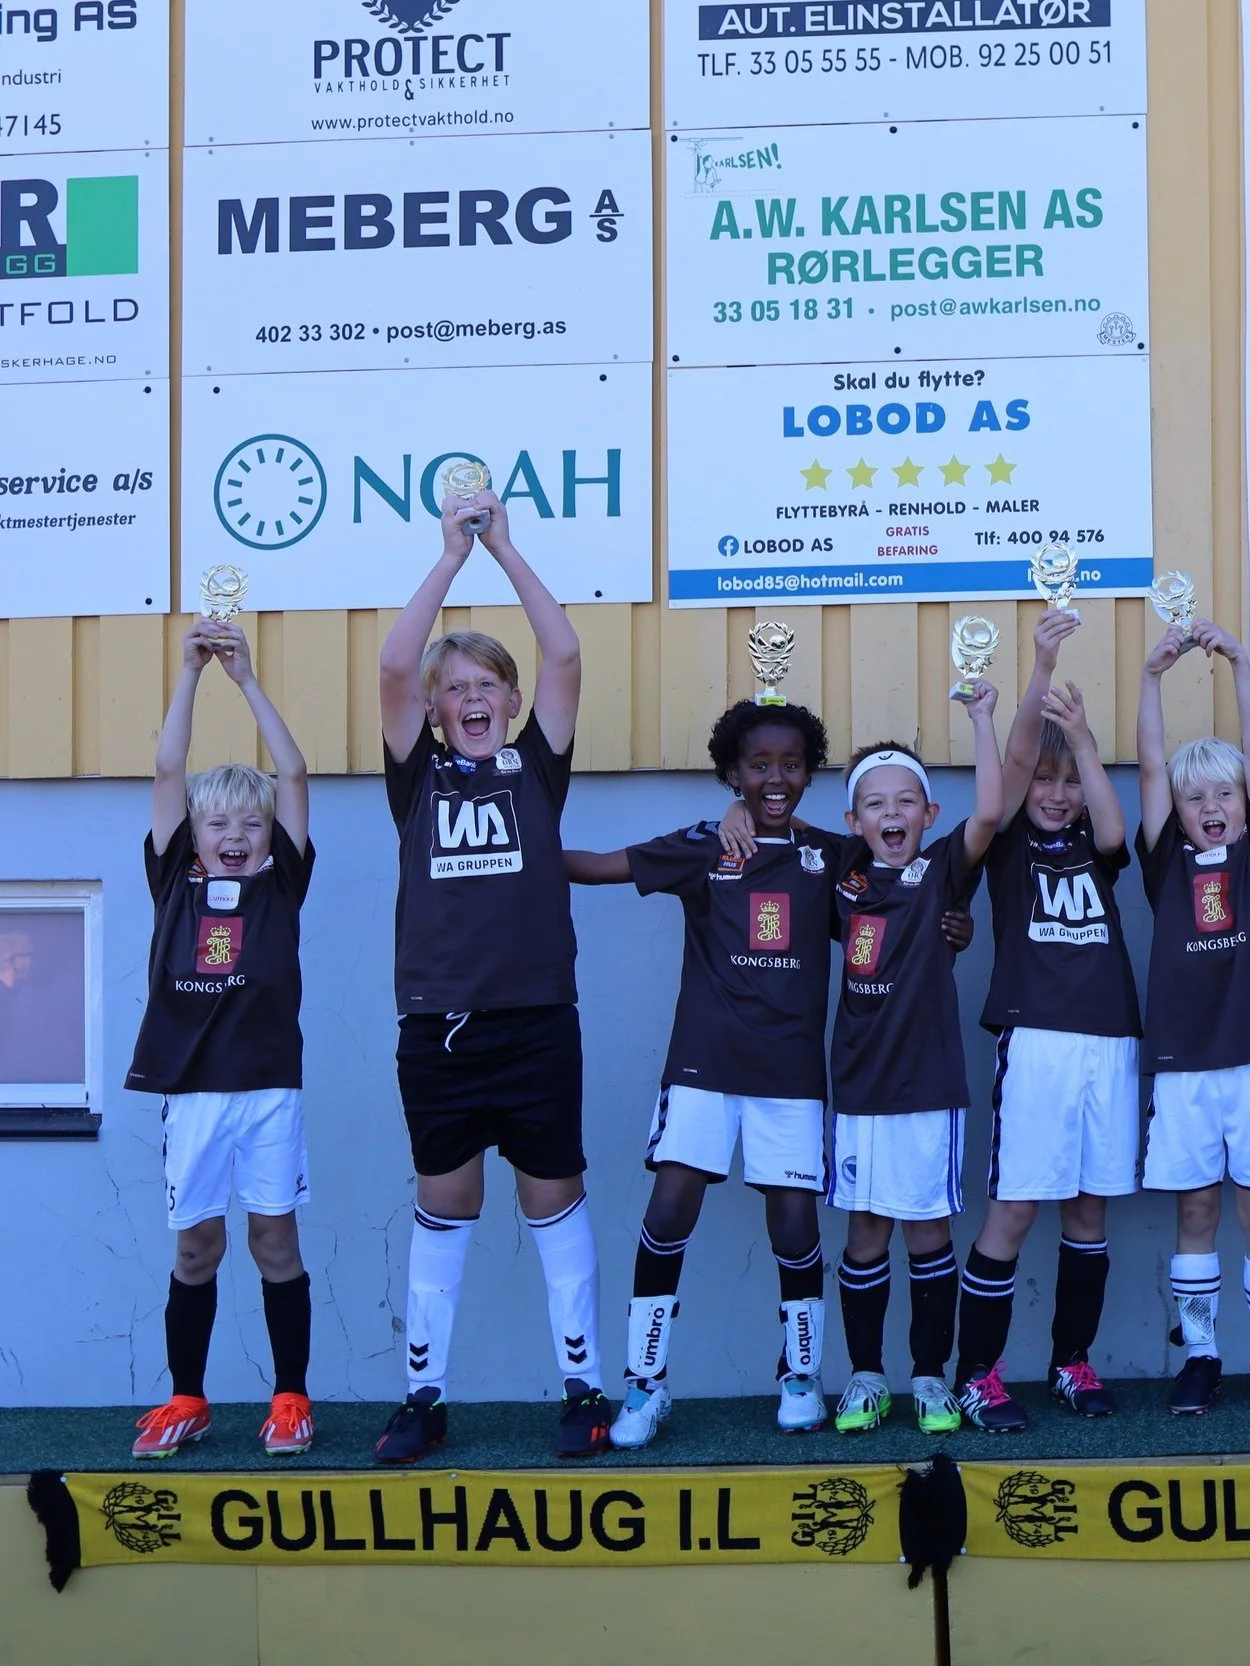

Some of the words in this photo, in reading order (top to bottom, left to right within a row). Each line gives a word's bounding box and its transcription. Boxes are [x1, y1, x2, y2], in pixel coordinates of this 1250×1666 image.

[74, 0, 137, 31] AS
[718, 7, 796, 35] AUT.
[805, 0, 1092, 32] ELINSTALLATØR
[314, 33, 511, 79] PROTECT
[698, 53, 741, 77] TLF.
[750, 51, 776, 75] 33
[785, 49, 813, 74] 05
[821, 48, 848, 73] 55
[855, 47, 882, 72] 55
[905, 44, 969, 71] MOB.
[979, 43, 1006, 68] 92
[1014, 42, 1041, 67] 25
[1050, 41, 1080, 66] 00
[1089, 40, 1112, 65] 51
[314, 79, 400, 94] VAKTHOLD
[419, 74, 510, 90] SIKKERHET
[311, 109, 515, 132] www.protectvakthold.no
[218, 186, 573, 255] MEBERG
[709, 198, 805, 240] A.W.
[821, 190, 1027, 236] KARLSEN
[1043, 187, 1103, 229] AS
[767, 244, 1044, 285] RØRLEGGER
[713, 301, 743, 323] 33
[750, 299, 780, 322] 05
[789, 298, 818, 321] 18
[826, 297, 854, 320] 31
[890, 297, 1101, 322] post@awkarlsen.no
[255, 325, 292, 343] 402
[299, 324, 323, 342] 33
[329, 323, 366, 341] 302
[386, 318, 567, 344] post@meberg.as
[1, 355, 117, 368] SKERHAGE.NO
[833, 372, 876, 391] Skal
[884, 371, 910, 390] du
[918, 370, 986, 392] flytte?
[783, 402, 946, 438] LOBOD
[968, 399, 1031, 432] AS
[113, 468, 154, 495] a/s
[353, 449, 622, 524] NOAH
[776, 500, 870, 520] FLYTTEBYRÅ
[888, 501, 966, 516] RENHOLD
[985, 499, 1040, 514] MALER
[743, 538, 804, 554] LOBOD
[811, 537, 834, 552] AS
[885, 526, 930, 538] GRATIS
[975, 531, 1001, 546] Tlf:
[1007, 530, 1043, 545] 400
[1048, 529, 1070, 543] 94
[1076, 528, 1105, 543] 576
[877, 543, 939, 557] BEFARING
[717, 572, 904, 592] lobod85@hotmail.com
[438, 800, 510, 848] WA
[437, 863, 454, 873] WA
[458, 858, 513, 871] GRUPPEN
[1038, 872, 1105, 920] WA
[1039, 928, 1055, 937] WA
[1059, 928, 1106, 941] GRUPPEN
[644, 1307, 665, 1367] umbro
[797, 1311, 813, 1366] umbro
[211, 1485, 645, 1552] GULLHAUG
[679, 1487, 761, 1551] I.L
